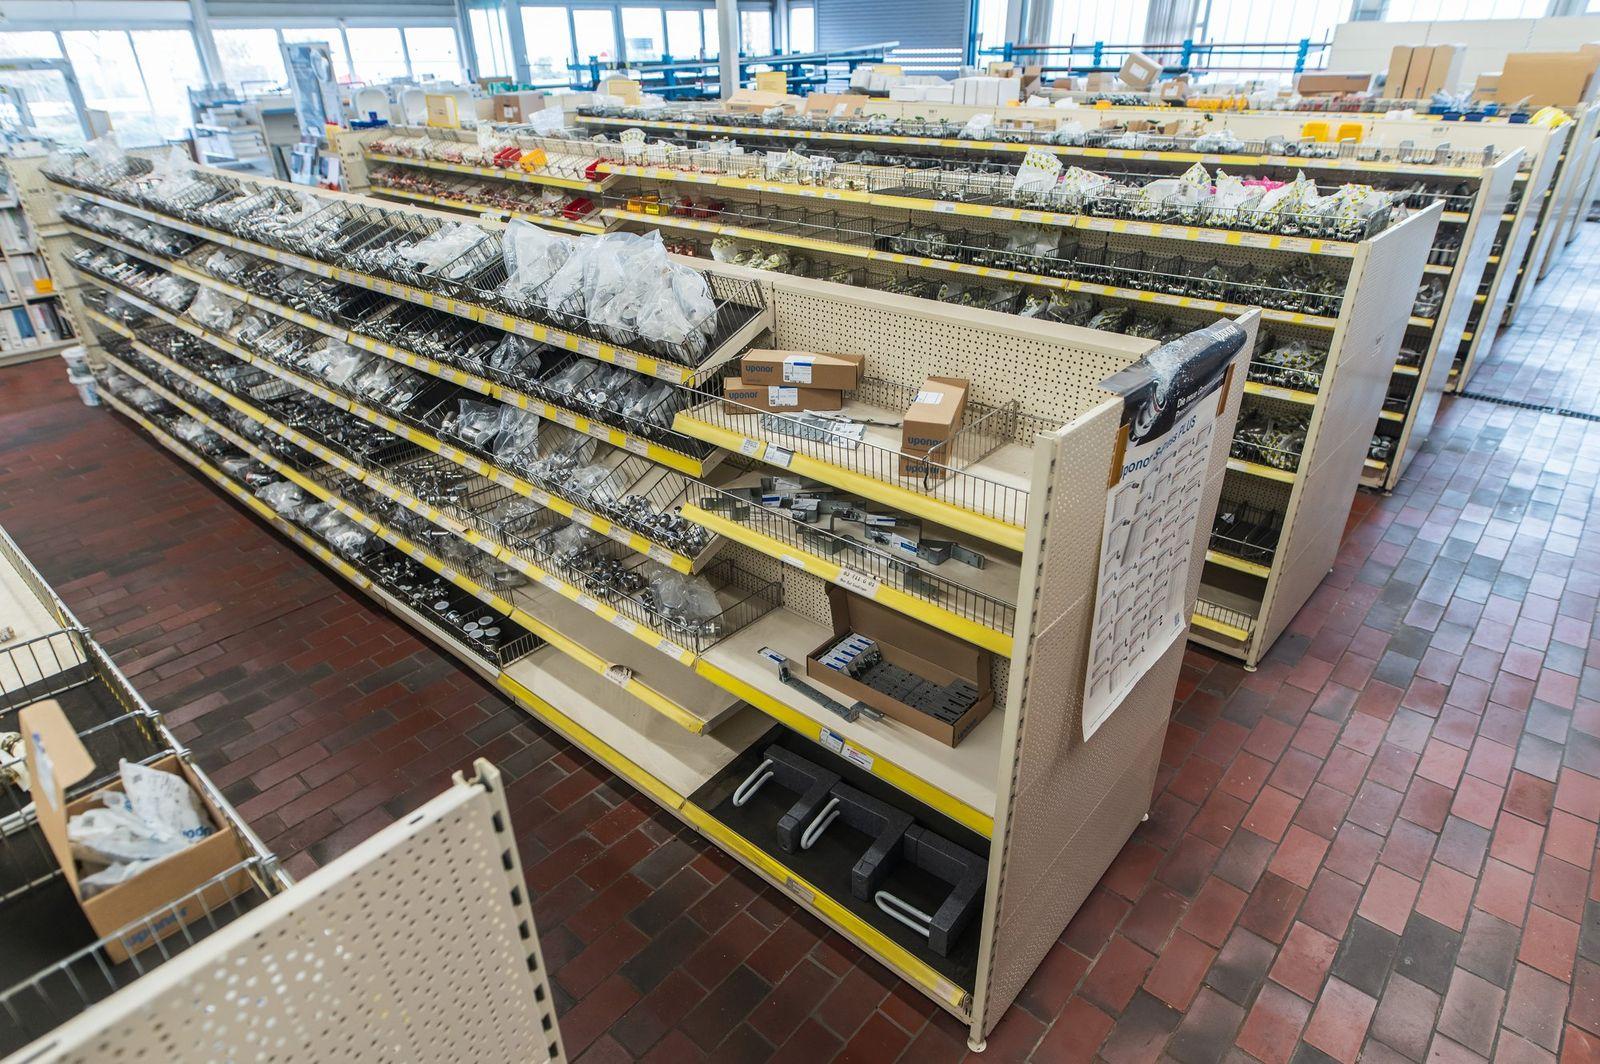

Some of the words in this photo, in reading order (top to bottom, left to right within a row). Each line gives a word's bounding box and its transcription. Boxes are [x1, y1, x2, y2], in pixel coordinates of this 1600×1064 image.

[745, 364, 774, 374] uponor
[728, 391, 758, 400] uponor
[1122, 455, 1153, 480] ponor
